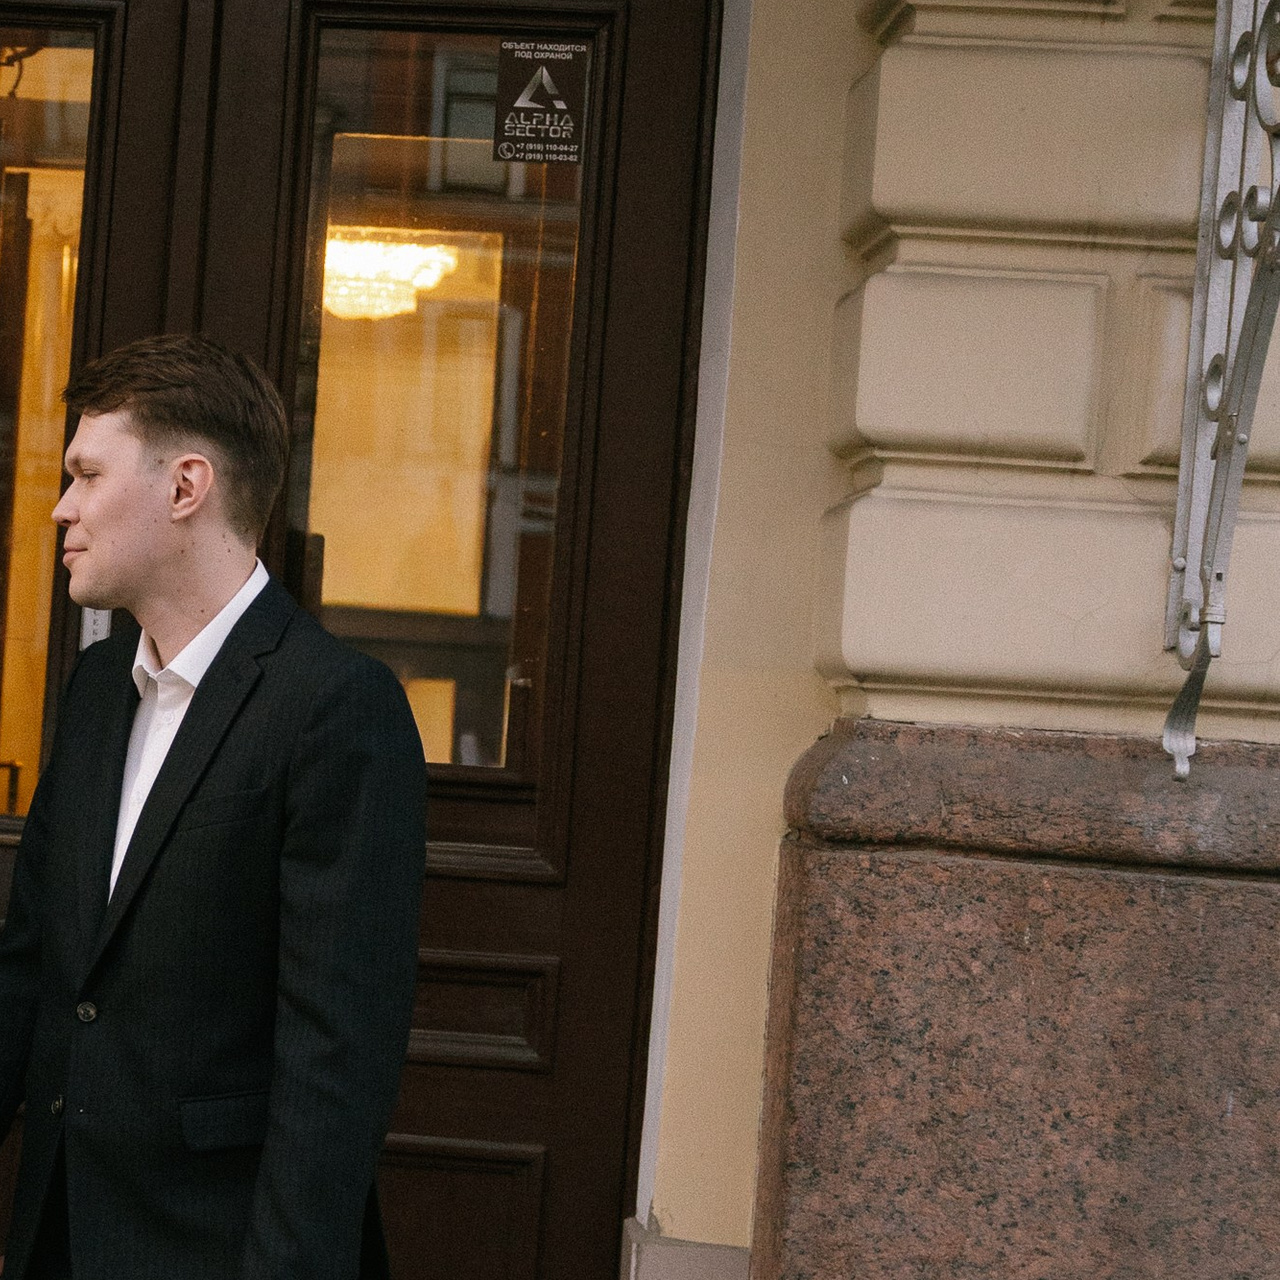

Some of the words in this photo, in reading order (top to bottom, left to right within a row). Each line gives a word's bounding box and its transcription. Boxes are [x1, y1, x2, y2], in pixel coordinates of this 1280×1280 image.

[502, 42, 535, 50] ОБЪЕКТ
[537, 43, 587, 52] НАХОДИТСЯ
[515, 51, 532, 59] ПОД
[534, 52, 573, 60] ОХРАНОЙ
[505, 112, 574, 126] ALPHA
[504, 124, 574, 138] SECTOR
